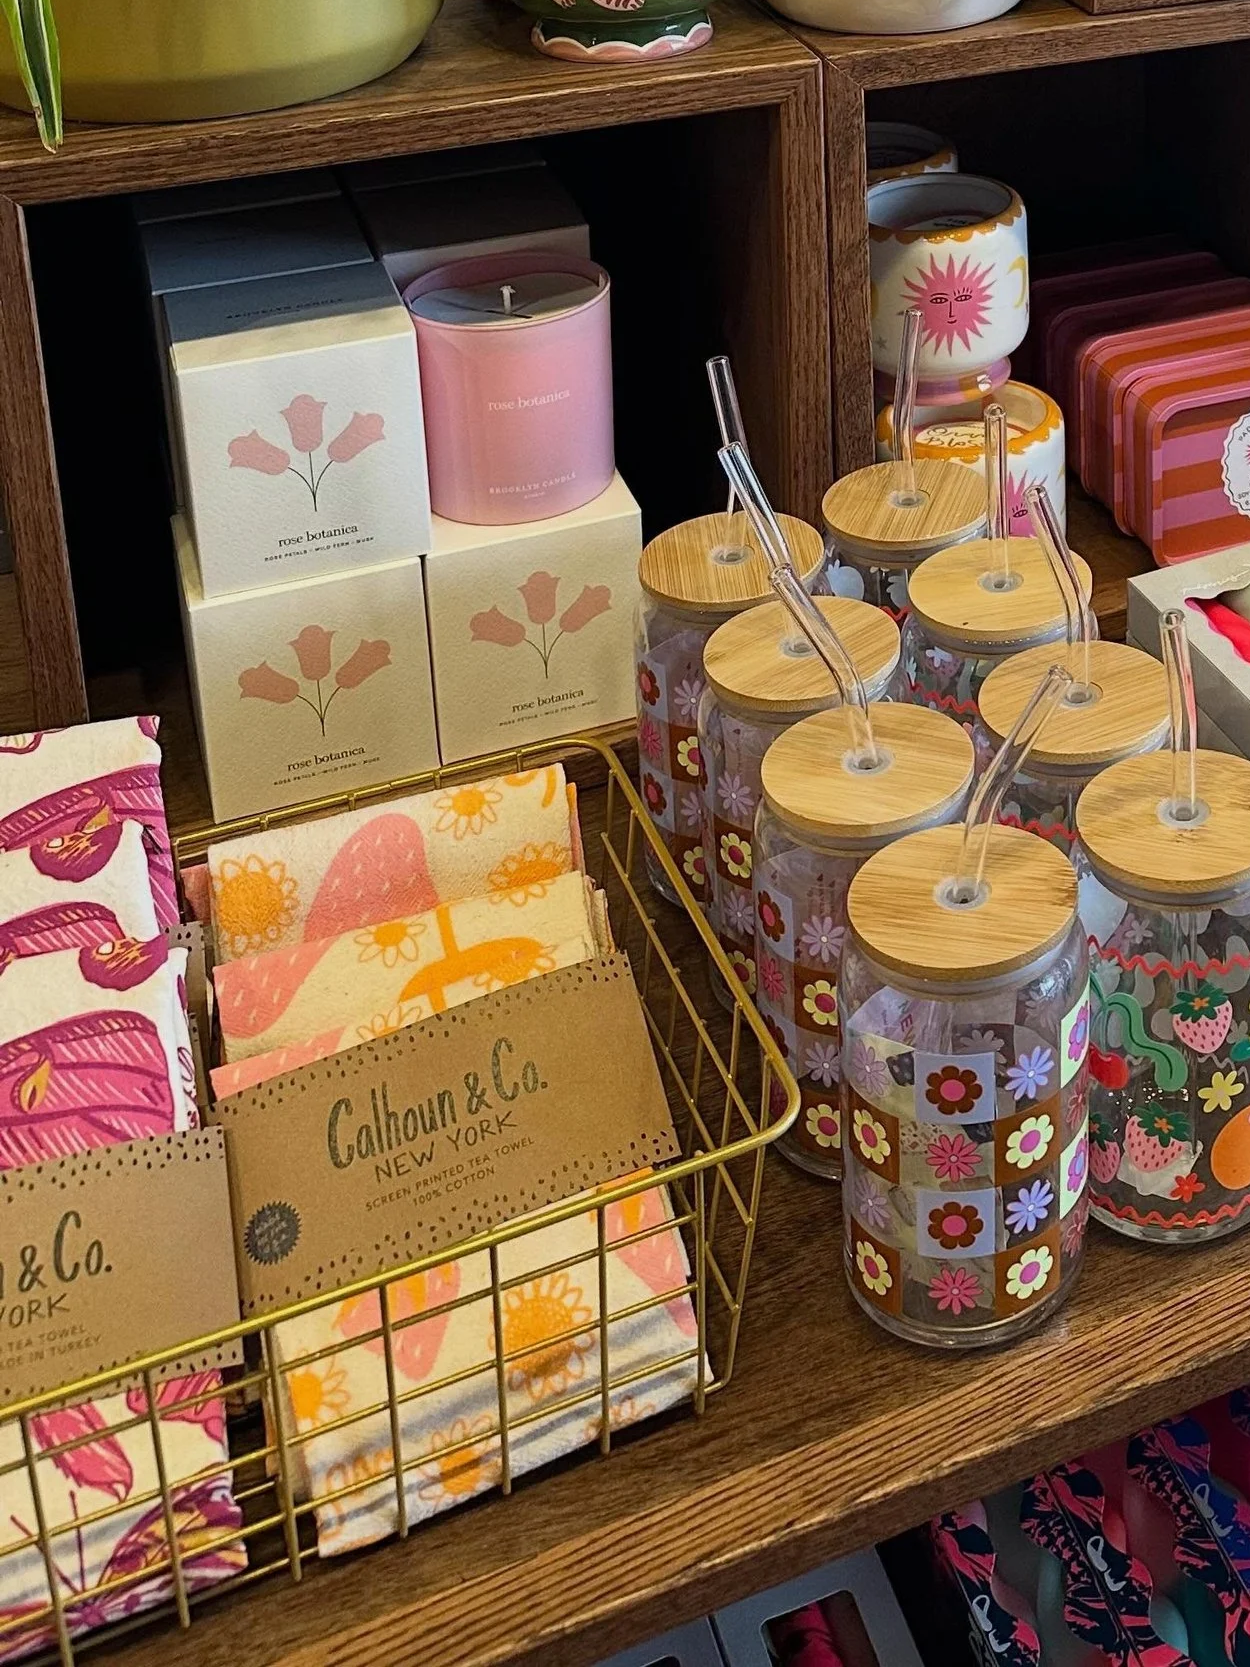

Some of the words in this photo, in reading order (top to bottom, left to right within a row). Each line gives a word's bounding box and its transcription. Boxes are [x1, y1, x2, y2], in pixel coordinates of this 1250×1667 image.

[488, 398, 515, 412] rose
[517, 387, 571, 409] botanica
[489, 480, 541, 495] BROOKLYN
[542, 472, 577, 489] CANDLE
[278, 535, 303, 547] rose
[306, 524, 358, 542] botanica
[512, 701, 535, 713] rose
[537, 688, 585, 708] botanica
[287, 759, 312, 773] rose
[314, 745, 366, 766] botanica
[326, 1081, 458, 1171] Calhoun
[464, 1069, 493, 1116] &
[491, 1036, 549, 1103] Co.
[374, 1145, 438, 1183] NEW
[446, 1110, 518, 1151] YORK
[365, 1186, 412, 1212] SCREEN
[414, 1162, 466, 1194] PRINTED
[467, 1154, 491, 1172] TEA
[491, 1136, 536, 1162] TOWEL
[412, 1188, 443, 1206] 100%
[445, 1167, 496, 1195] COTTON
[18, 1244, 47, 1292] &
[53, 1210, 113, 1283] Co.
[8, 1338, 33, 1352] TEA
[38, 1324, 87, 1342] TOWEL
[29, 1350, 45, 1363] IN
[47, 1334, 101, 1357] TURKEY
